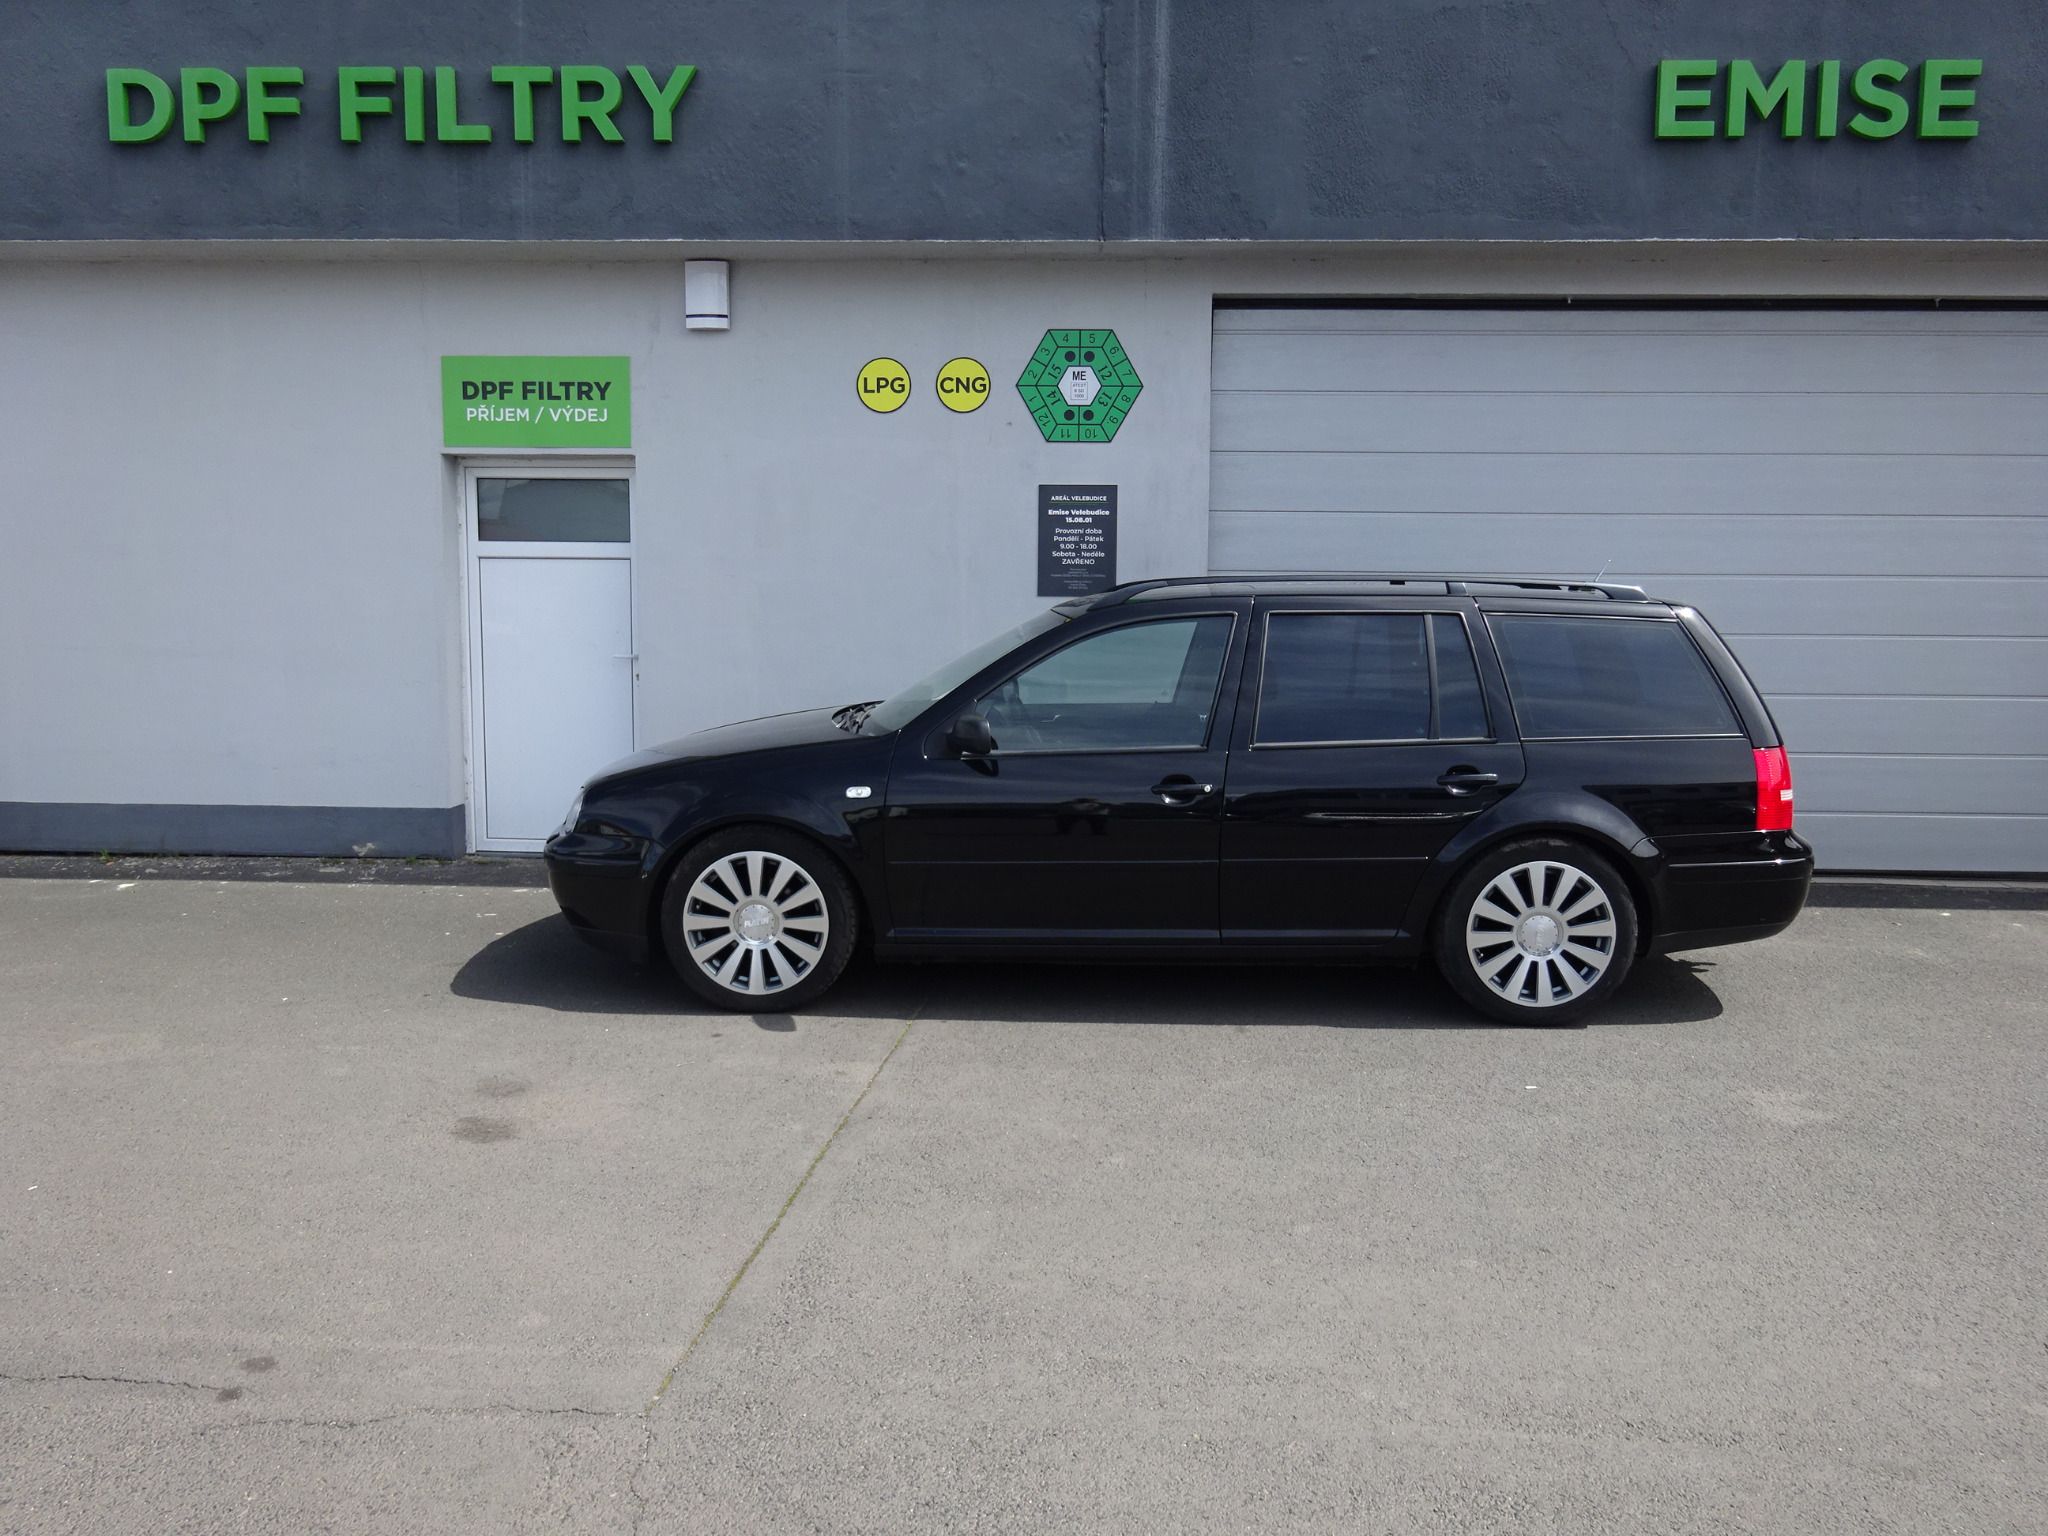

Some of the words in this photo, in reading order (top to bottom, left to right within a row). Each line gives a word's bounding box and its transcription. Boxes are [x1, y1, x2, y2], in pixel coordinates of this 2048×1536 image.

[106, 66, 304, 143] DPF
[338, 65, 697, 143] FILTRY
[1655, 58, 1983, 140] EMISE
[1062, 334, 1069, 343] 4
[1089, 334, 1096, 343] 5
[1041, 347, 1050, 356] 3
[1028, 370, 1038, 378] 2
[1048, 364, 1062, 379] 15
[1072, 371, 1086, 380] ME
[1098, 365, 1112, 380] 12
[462, 381, 514, 400] DPF
[522, 381, 612, 400] FILTRY
[863, 377, 905, 393] LPG
[940, 377, 987, 393] CNG
[1046, 389, 1060, 405] 14
[1098, 392, 1112, 406] 13
[1122, 395, 1131, 403] 8
[467, 405, 529, 421] PŘÍJEM
[535, 407, 544, 424] /
[549, 405, 608, 422] VÝDEJ
[1038, 414, 1050, 428] 12
[1060, 429, 1071, 438] 11
[1085, 429, 1097, 438] 10
